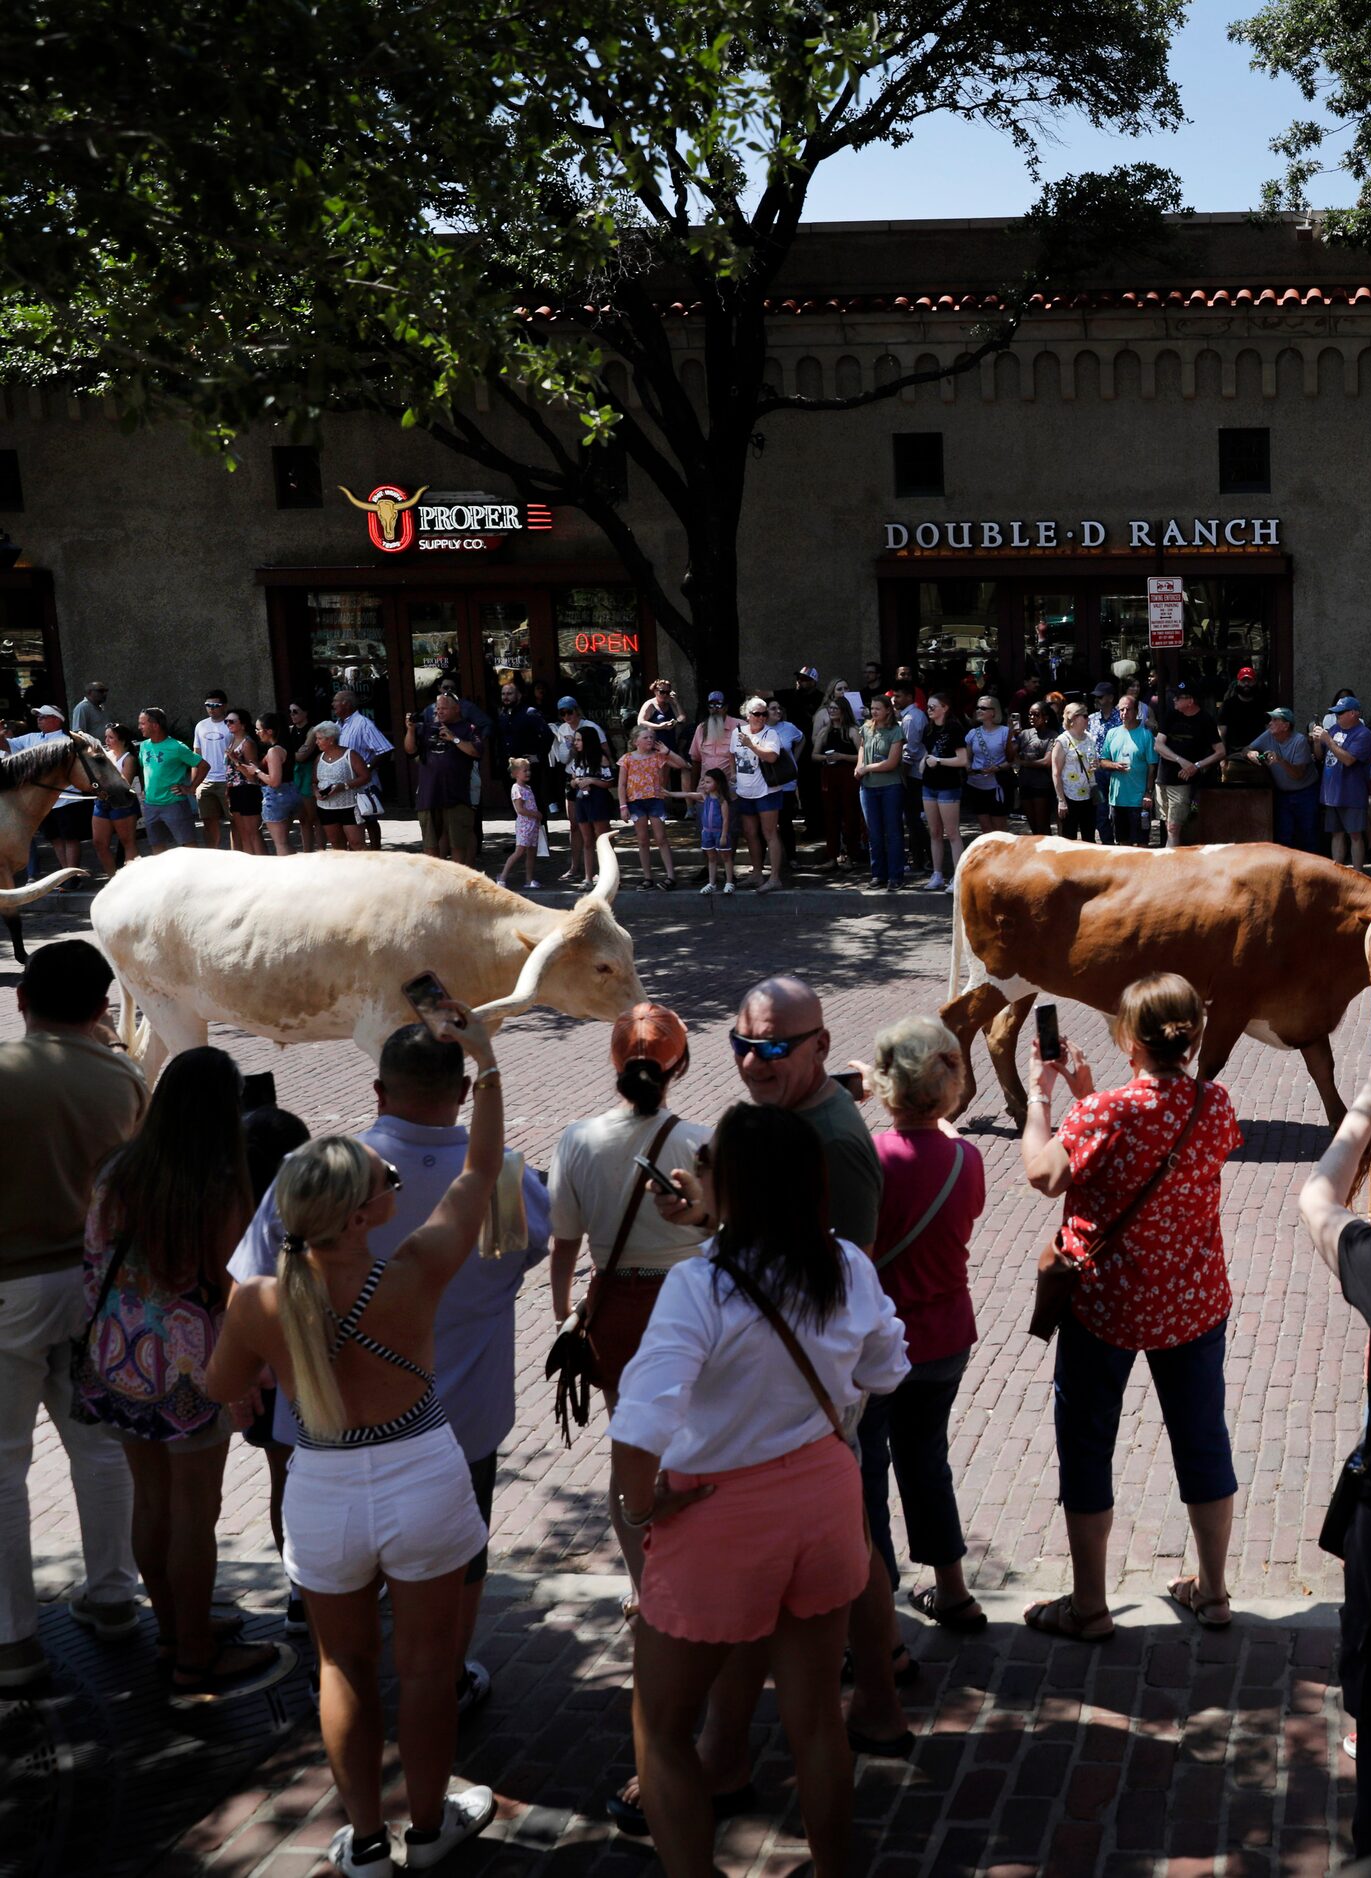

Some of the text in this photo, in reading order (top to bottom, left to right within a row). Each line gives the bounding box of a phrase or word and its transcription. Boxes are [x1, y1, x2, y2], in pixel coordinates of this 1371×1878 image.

[418, 504, 523, 531] PROPER
[418, 538, 487, 551] SUPPLY CO.
[1129, 518, 1281, 547] RANCH
[575, 633, 641, 654] OPEN
